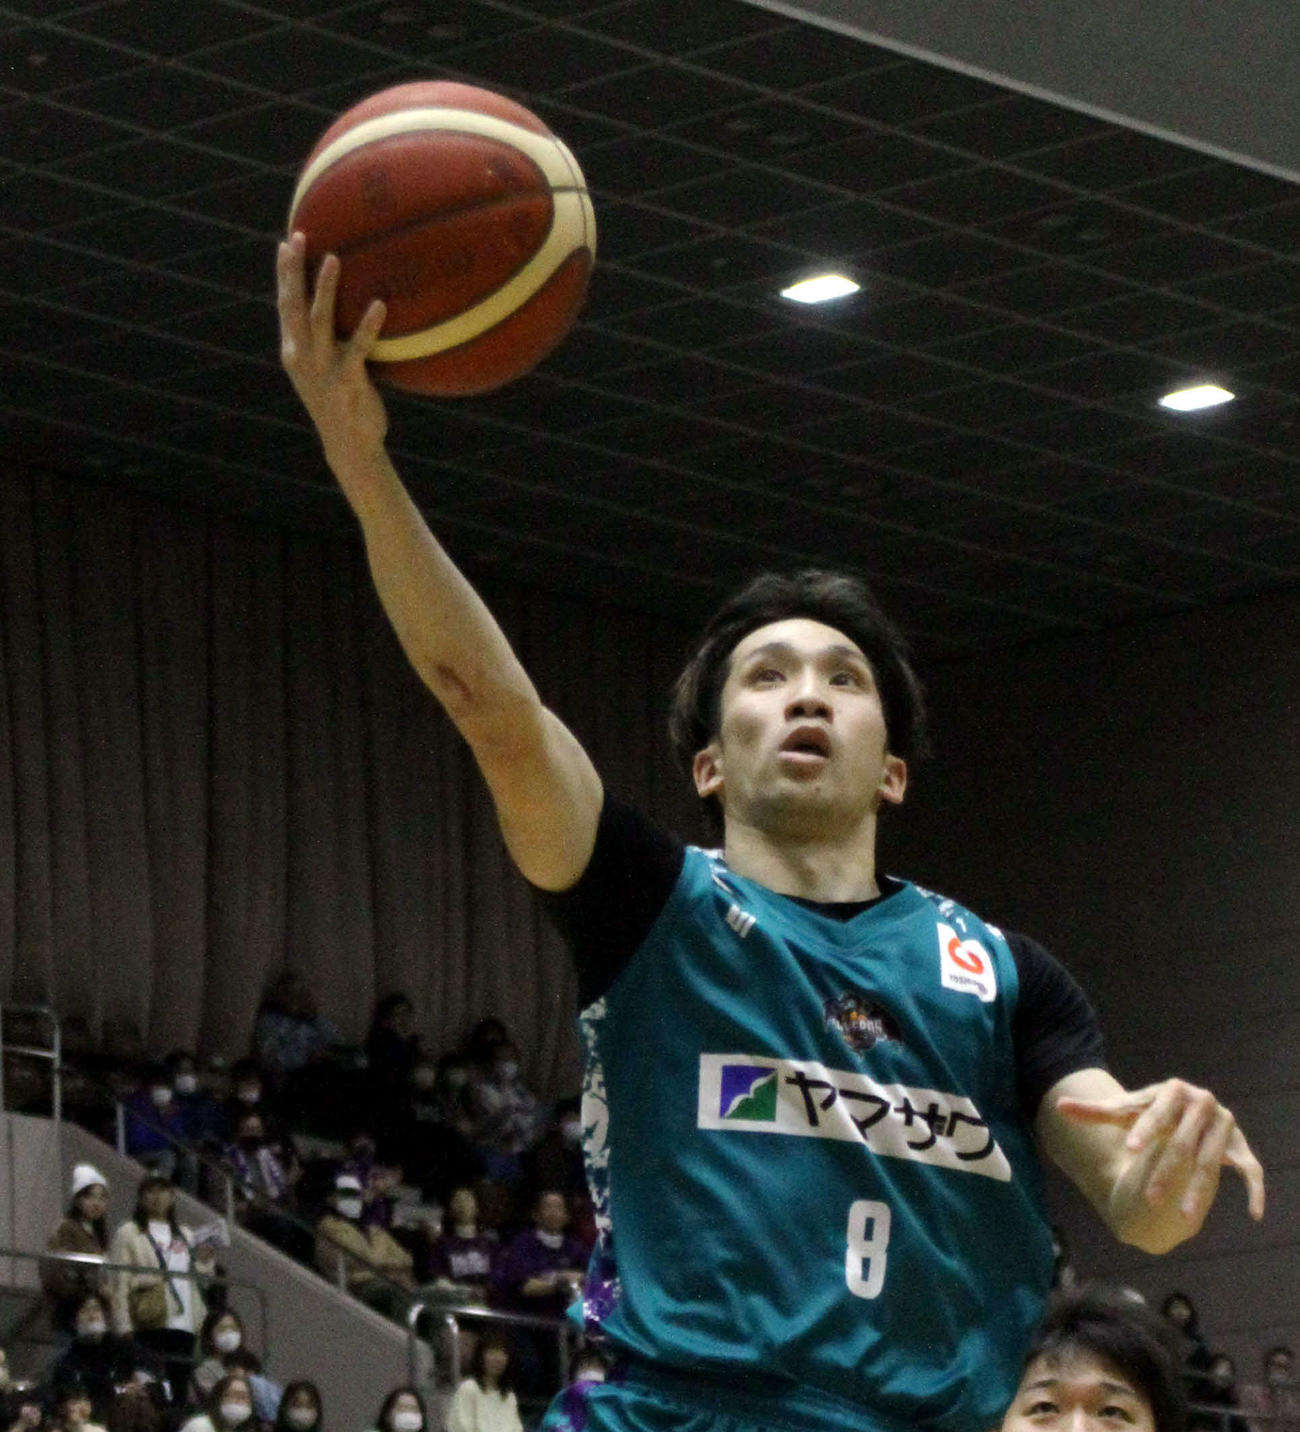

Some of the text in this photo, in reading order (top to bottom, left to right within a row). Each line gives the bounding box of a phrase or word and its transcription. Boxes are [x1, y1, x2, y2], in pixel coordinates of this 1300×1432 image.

[784, 1070, 995, 1162] ヤマザワ
[845, 1199, 892, 1301] 8
